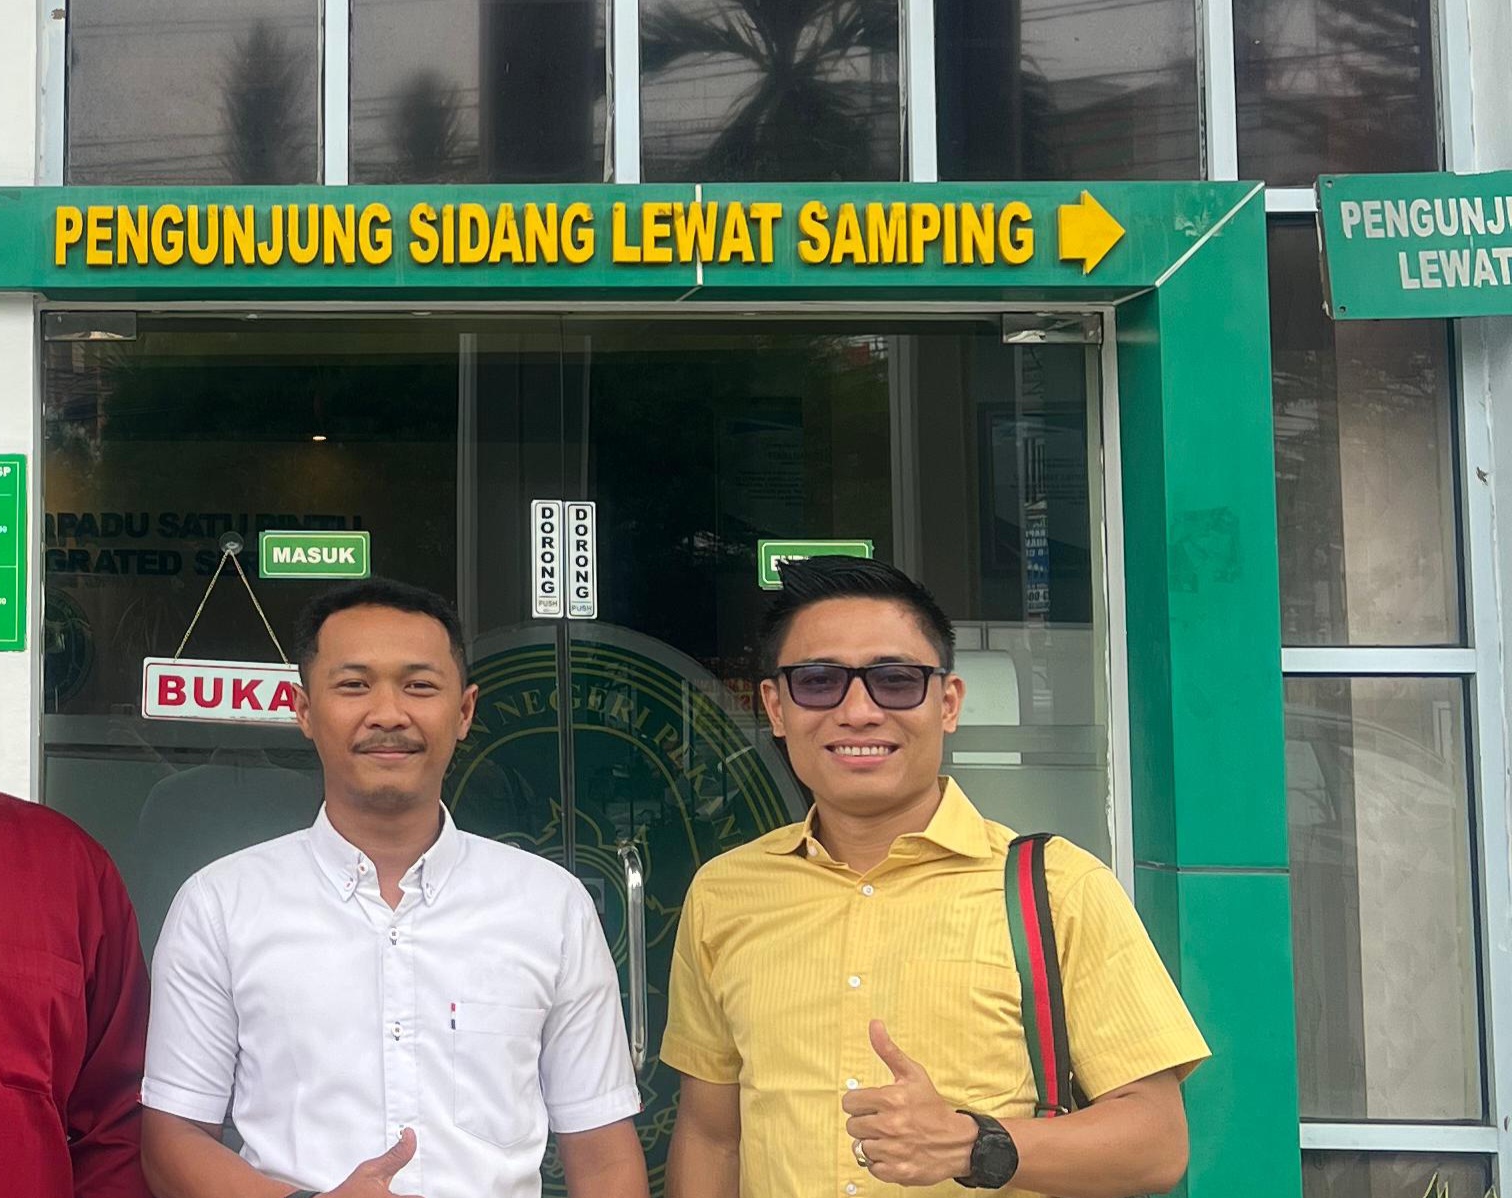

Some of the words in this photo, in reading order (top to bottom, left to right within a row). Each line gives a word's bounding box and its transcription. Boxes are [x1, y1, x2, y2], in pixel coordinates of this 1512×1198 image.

[55, 202, 392, 266] PENGUNJUNG
[409, 201, 594, 266] SIDANG
[611, 201, 782, 265] LEWAT
[797, 201, 1034, 265] SAMPING
[272, 547, 356, 565] MASUK
[541, 507, 555, 594] DORONG
[575, 508, 589, 599] DORONG
[539, 600, 557, 608] PUSH
[158, 675, 297, 713] BUKA
[492, 683, 651, 731] NEGERI
